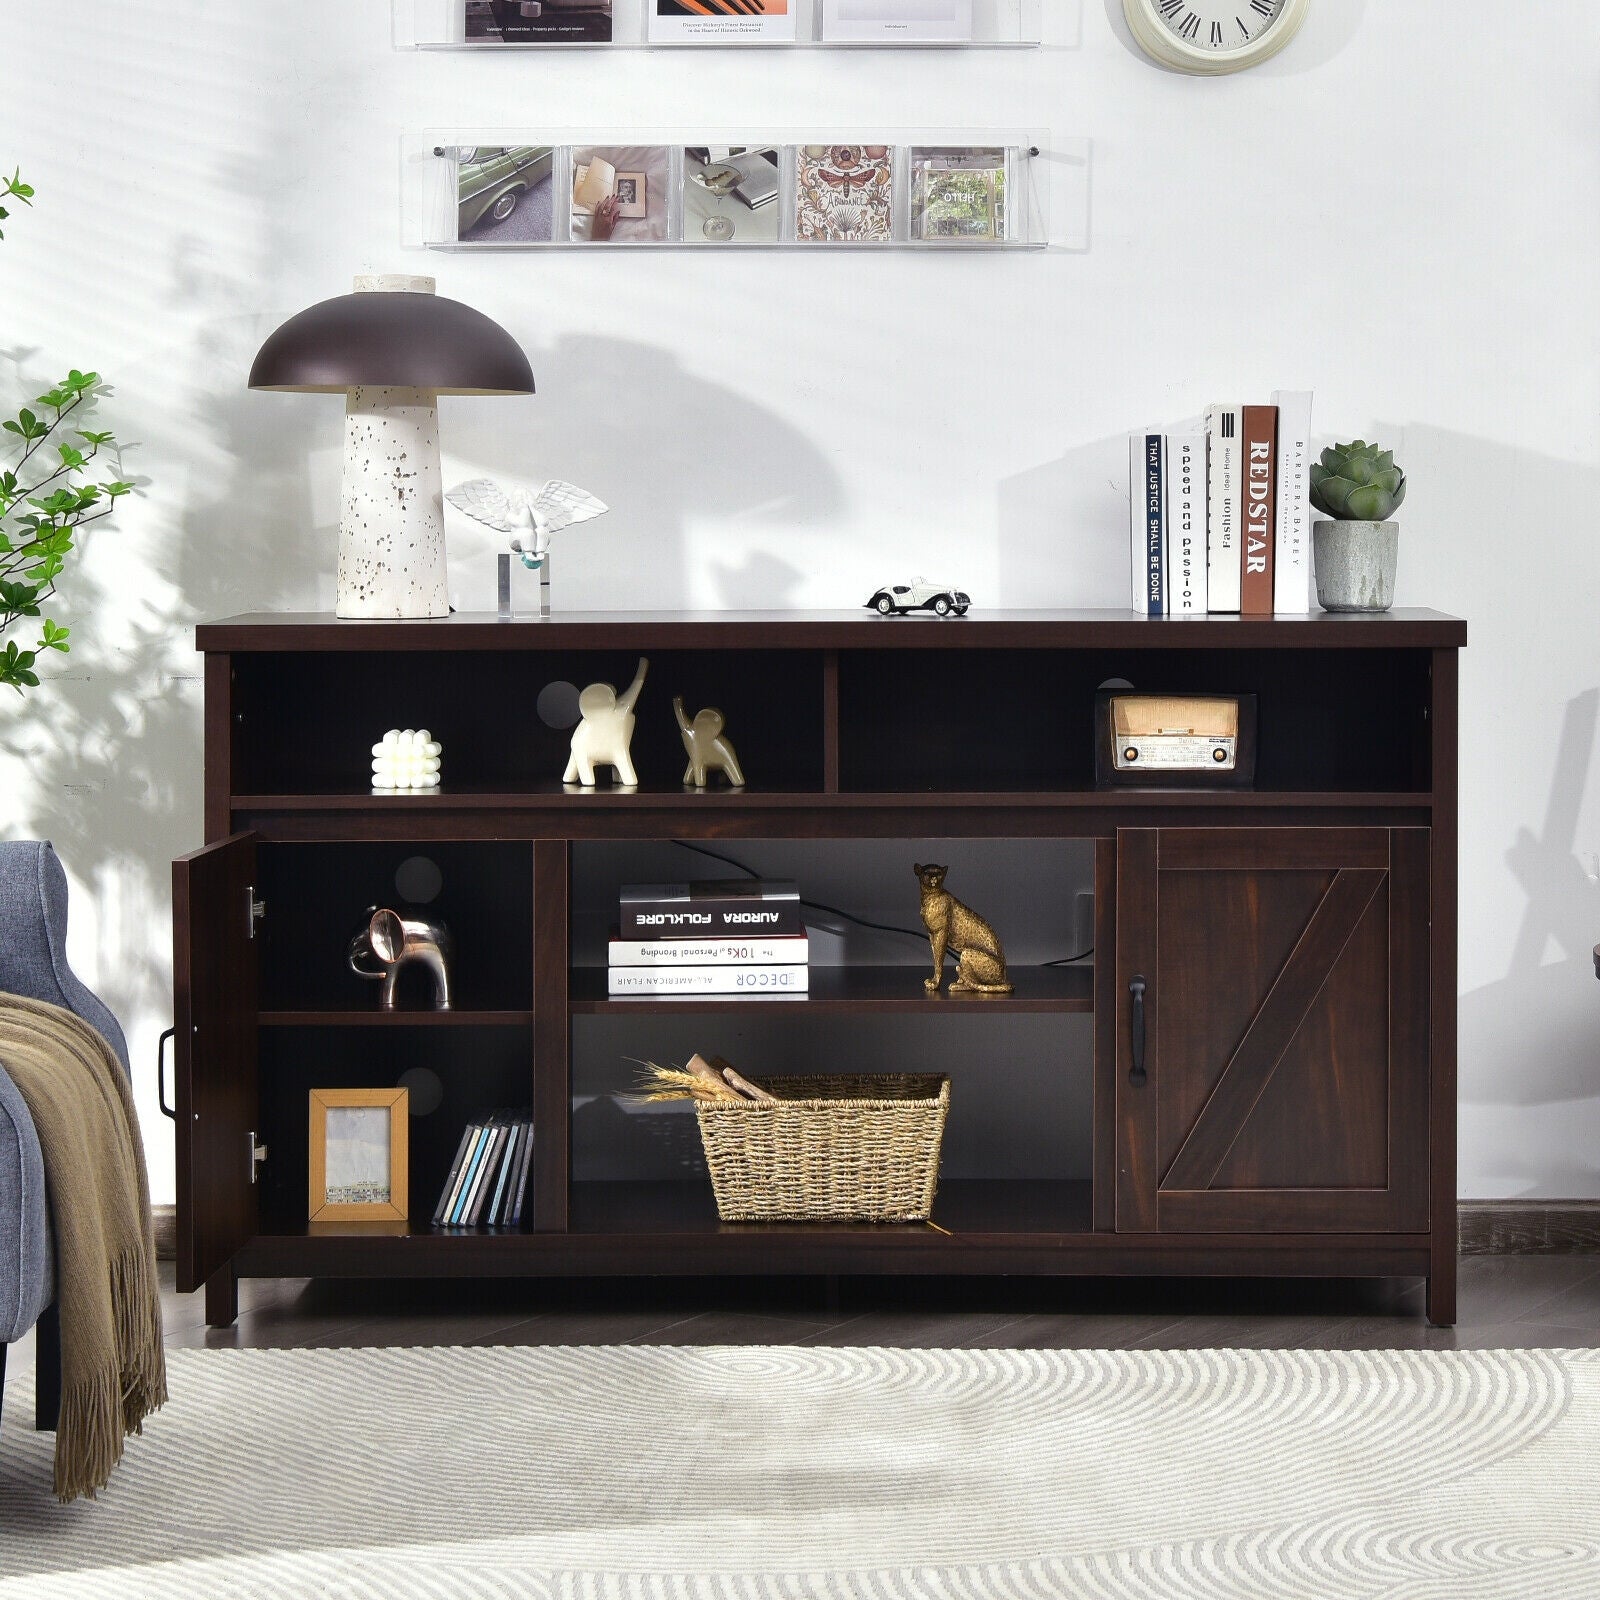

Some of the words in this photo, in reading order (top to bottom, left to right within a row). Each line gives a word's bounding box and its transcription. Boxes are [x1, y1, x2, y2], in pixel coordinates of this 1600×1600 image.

[1149, 441, 1158, 468] THAT
[1223, 447, 1231, 470] Home
[1182, 445, 1192, 495] speed
[1223, 472, 1231, 491] Ideal
[1149, 470, 1158, 513] JUSTICE
[1182, 502, 1191, 530] and
[1246, 440, 1270, 575] REDSTAR
[1150, 519, 1159, 553] SHALL
[1222, 497, 1232, 549] Fashion
[1150, 556, 1159, 569] BE
[1182, 538, 1192, 608] passion
[1151, 572, 1159, 602] DONE
[636, 913, 712, 925] FOLKLORE
[723, 911, 779, 924] AURORA
[736, 973, 788, 986] DECOR
